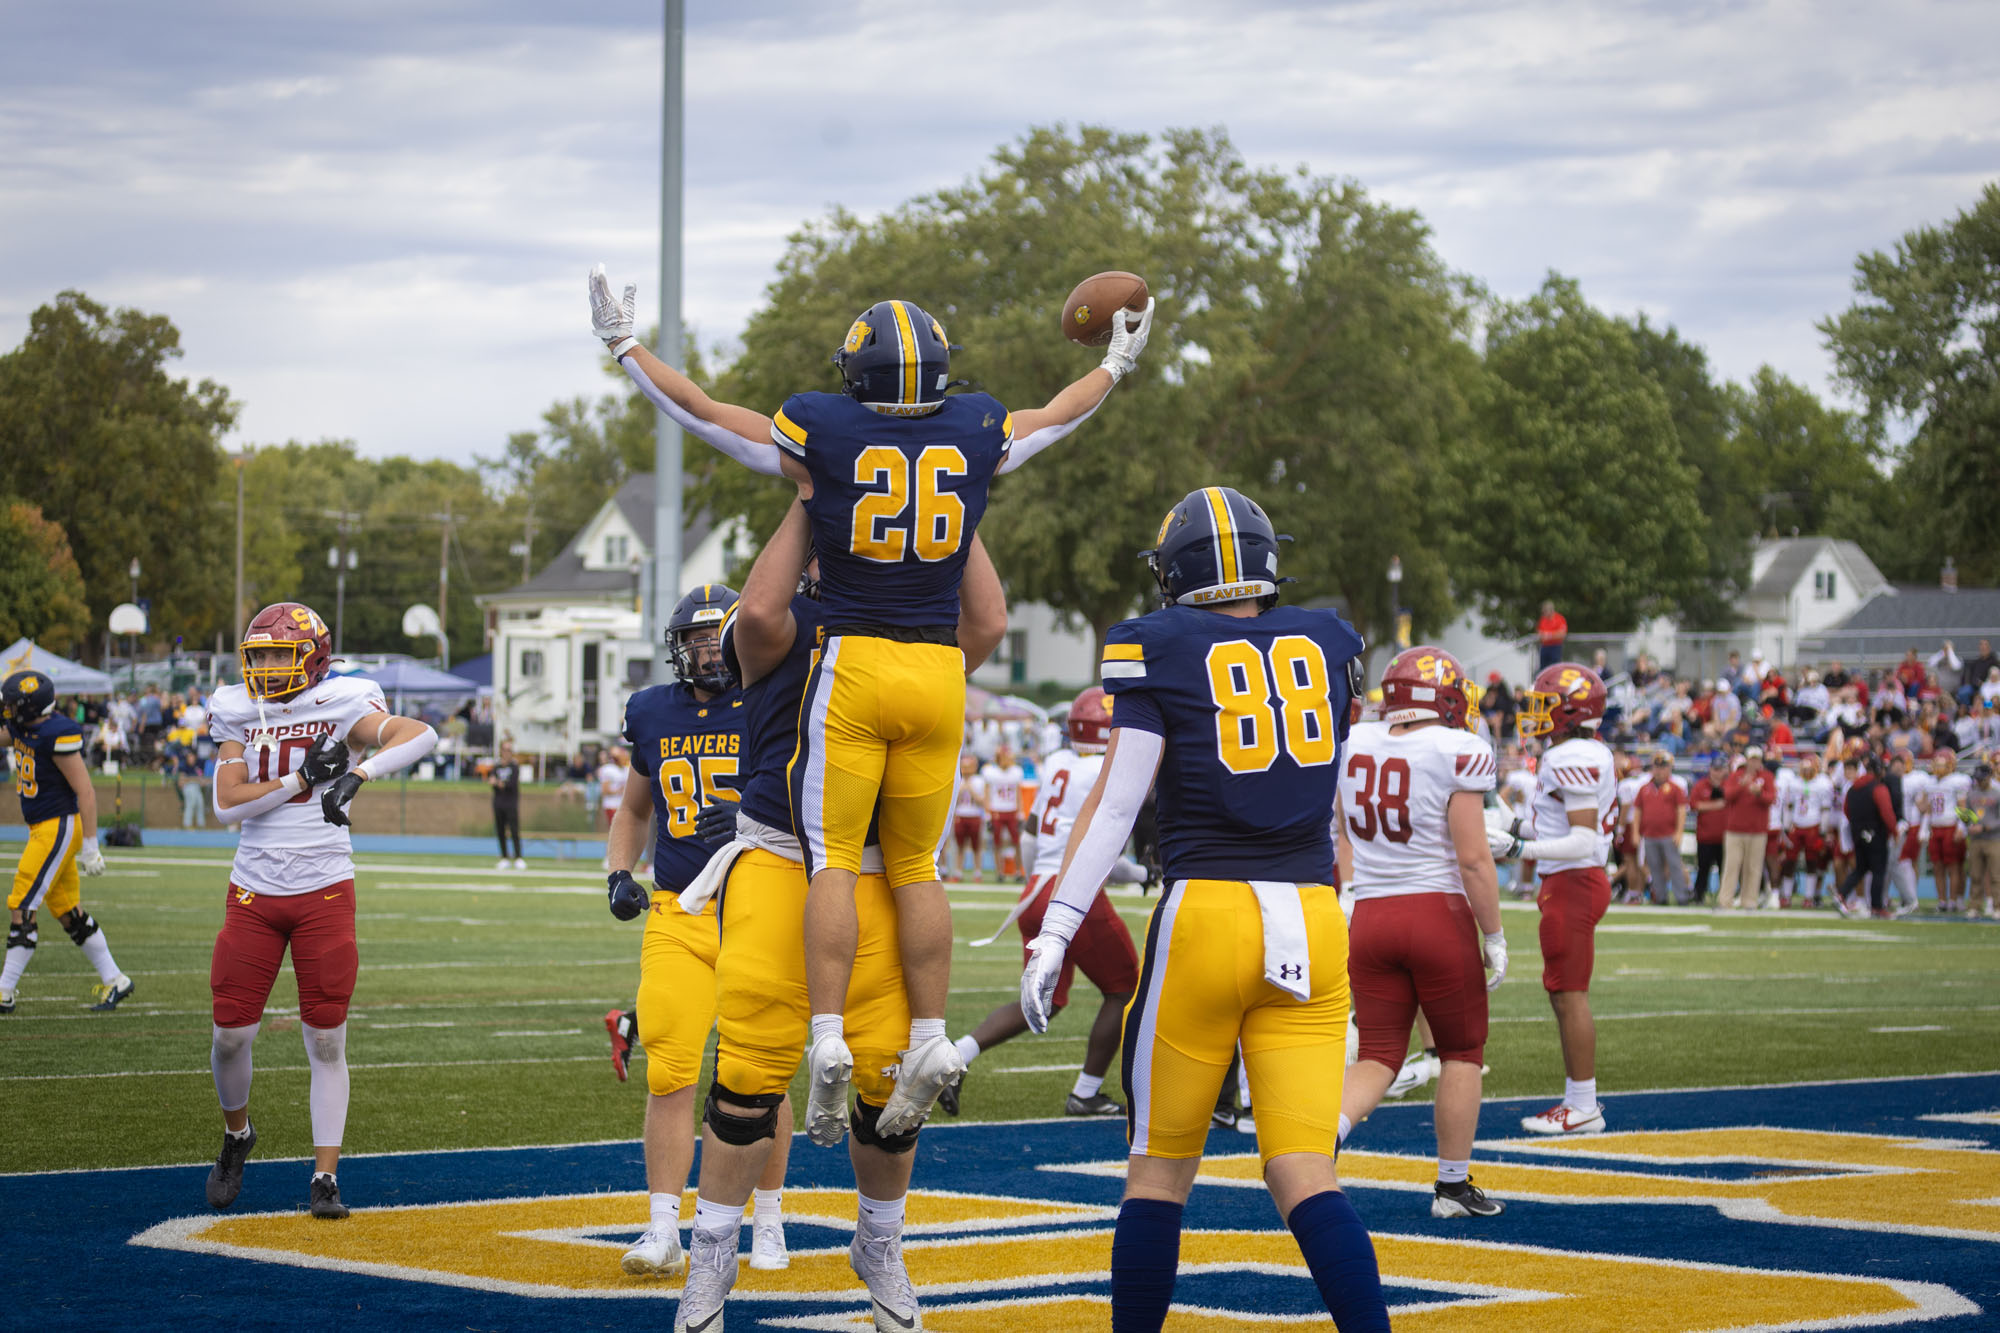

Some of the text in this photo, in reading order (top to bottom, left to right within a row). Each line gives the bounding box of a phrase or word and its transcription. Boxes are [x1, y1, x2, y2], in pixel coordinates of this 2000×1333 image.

[850, 445, 968, 562] 26
[1194, 584, 1262, 603] BEAVERS
[660, 734, 740, 758] BEAVERS
[1205, 635, 1336, 774] 88
[659, 756, 742, 838] 85
[1347, 754, 1413, 844] 38
